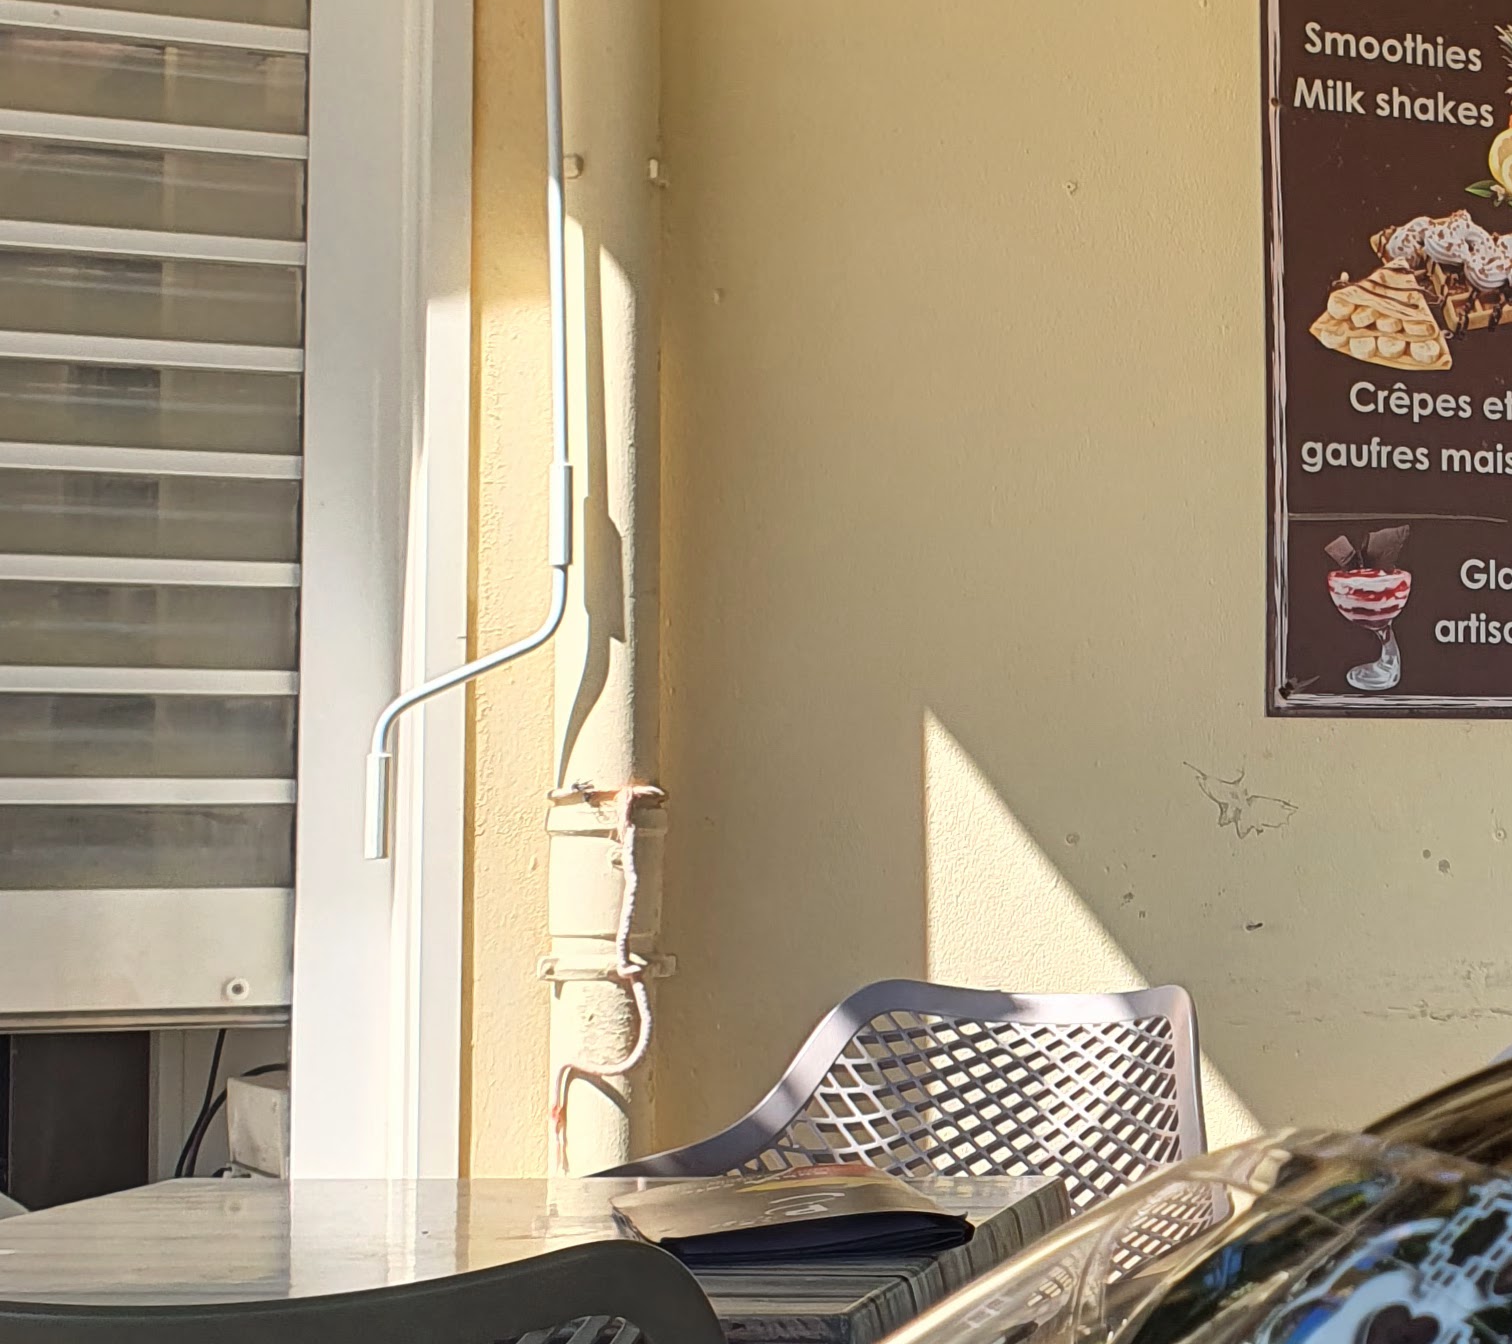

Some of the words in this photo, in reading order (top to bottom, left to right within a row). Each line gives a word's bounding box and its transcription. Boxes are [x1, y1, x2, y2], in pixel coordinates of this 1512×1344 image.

[1304, 21, 1483, 72] Smoothies
[1293, 76, 1367, 115] Milk
[1375, 86, 1494, 128] shakes
[1349, 381, 1472, 423] Crêpes
[1300, 436, 1431, 473] gaufres
